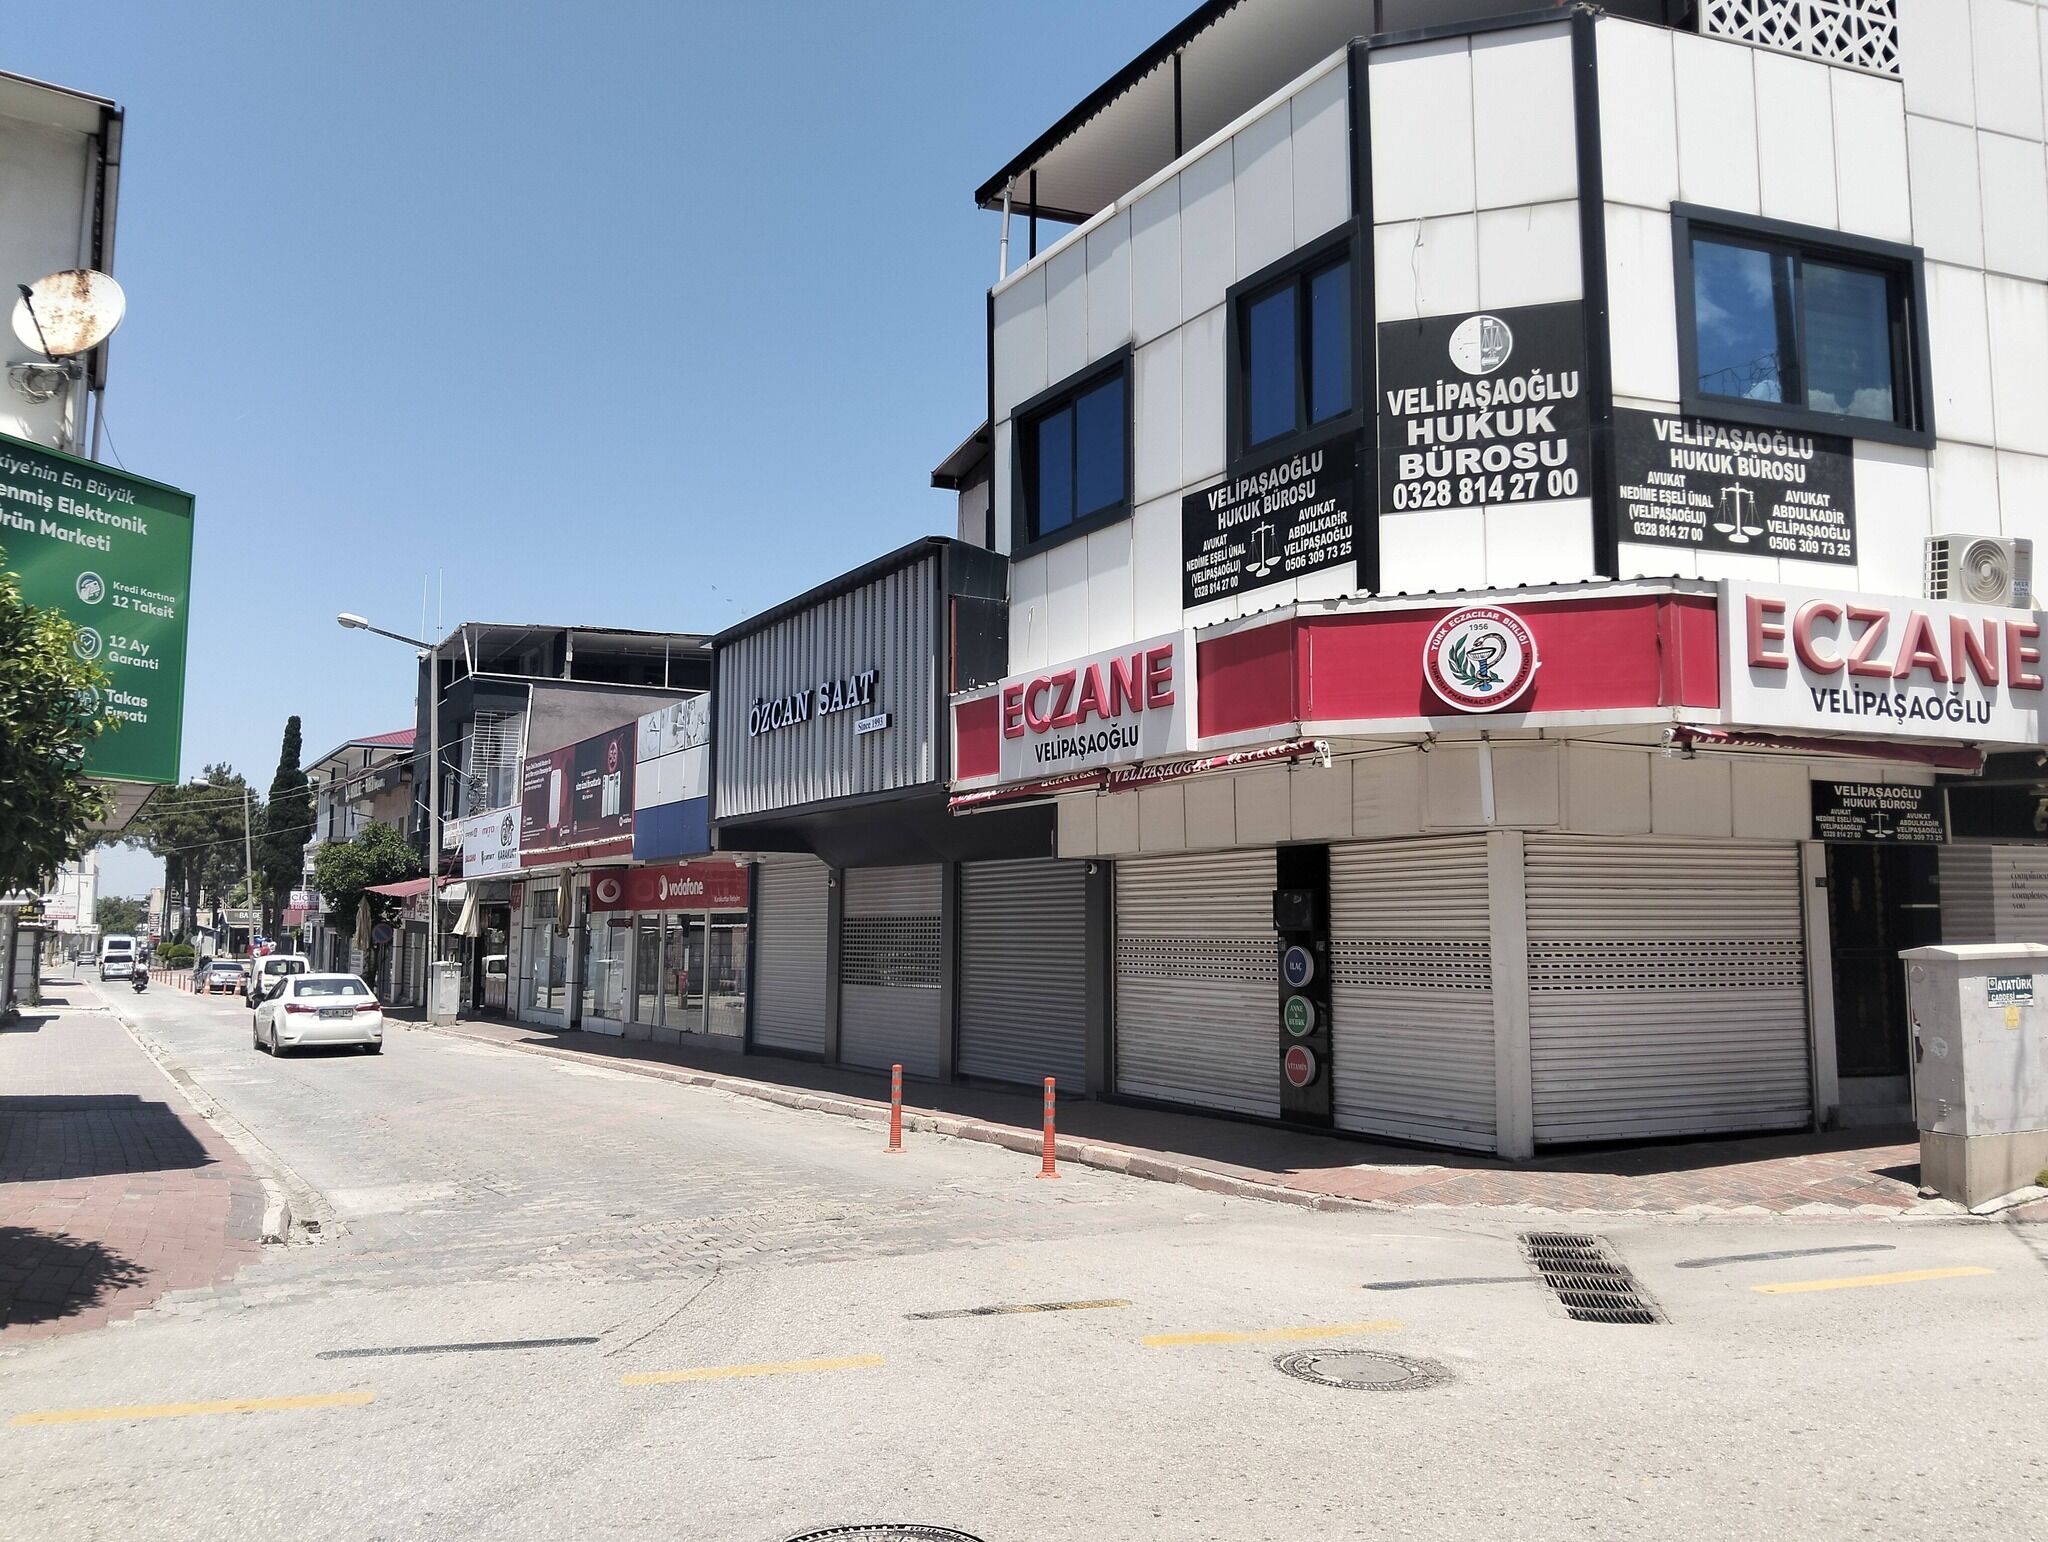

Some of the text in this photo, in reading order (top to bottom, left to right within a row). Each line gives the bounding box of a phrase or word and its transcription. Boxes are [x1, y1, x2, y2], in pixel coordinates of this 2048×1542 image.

[1386, 369, 1579, 416] VELİPAŞAOĞLU
[1406, 405, 1556, 446] HUKUK
[1652, 418, 1814, 460] VELİPAŞAOĞLU
[1399, 438, 1568, 480] BÜROSU
[1671, 448, 1806, 484] HUKUK BÜROSU
[61, 471, 82, 490] En
[86, 479, 136, 505] Büyük
[1207, 450, 1324, 511] VELİPAŞAOĞLU
[1393, 468, 1578, 510] 0328 814 27 00
[1647, 471, 1686, 488] AVUKAT
[1217, 478, 1316, 531] HUKUK BÜROSU
[1619, 485, 1714, 508] NEDİME EŞELİ ÜNAL
[1785, 490, 1831, 507] AVUKAT
[58, 495, 148, 535] Elektronik
[1298, 499, 1336, 522] AVUKAT
[1629, 505, 1706, 528] (VELİPAŞAOĞLU)
[1772, 504, 1845, 525] ABDULKADİR
[40, 518, 111, 552] Marketi
[1288, 510, 1348, 540] ABDULKADİR
[1634, 521, 1703, 541] 0328 814 27 00
[1767, 519, 1851, 541] VELİPAŞAOĞLU
[1203, 534, 1228, 552] AVUKAT
[1284, 525, 1353, 557] VELİPAŞAOĞLU
[1769, 536, 1851, 557] 0506 309 73 25
[1285, 541, 1352, 572] 0506 309 73 25
[1191, 560, 1241, 586] (VELİPAŞAOĞLU)
[112, 581, 176, 603] Kredi Kartına
[1194, 576, 1239, 598] 0328 814 27 00
[112, 595, 174, 619] 12 Taksit
[1431, 611, 1529, 651] TÜRK ECZACILAR BİRLİĞİ
[1469, 623, 1489, 631] 1956
[109, 635, 150, 656] 12 Ay
[1745, 593, 2044, 690] ECZANE
[108, 651, 159, 670] Garanti
[104, 688, 148, 708] Takas
[1004, 642, 1175, 740] ECZANE
[750, 670, 878, 737] ÖZCAN SAAT
[1810, 683, 1992, 725] VELİPAŞAOĞLU
[858, 716, 884, 731] Since 1993
[1034, 723, 1139, 763] VELİPAŞAOĞLU
[1834, 784, 1922, 799] VELİPAŞAOĞLU
[1843, 798, 1918, 810] HUKUK BÜROSU
[669, 877, 704, 896] vodafone
[1997, 977, 2032, 991] ATATÜRK
